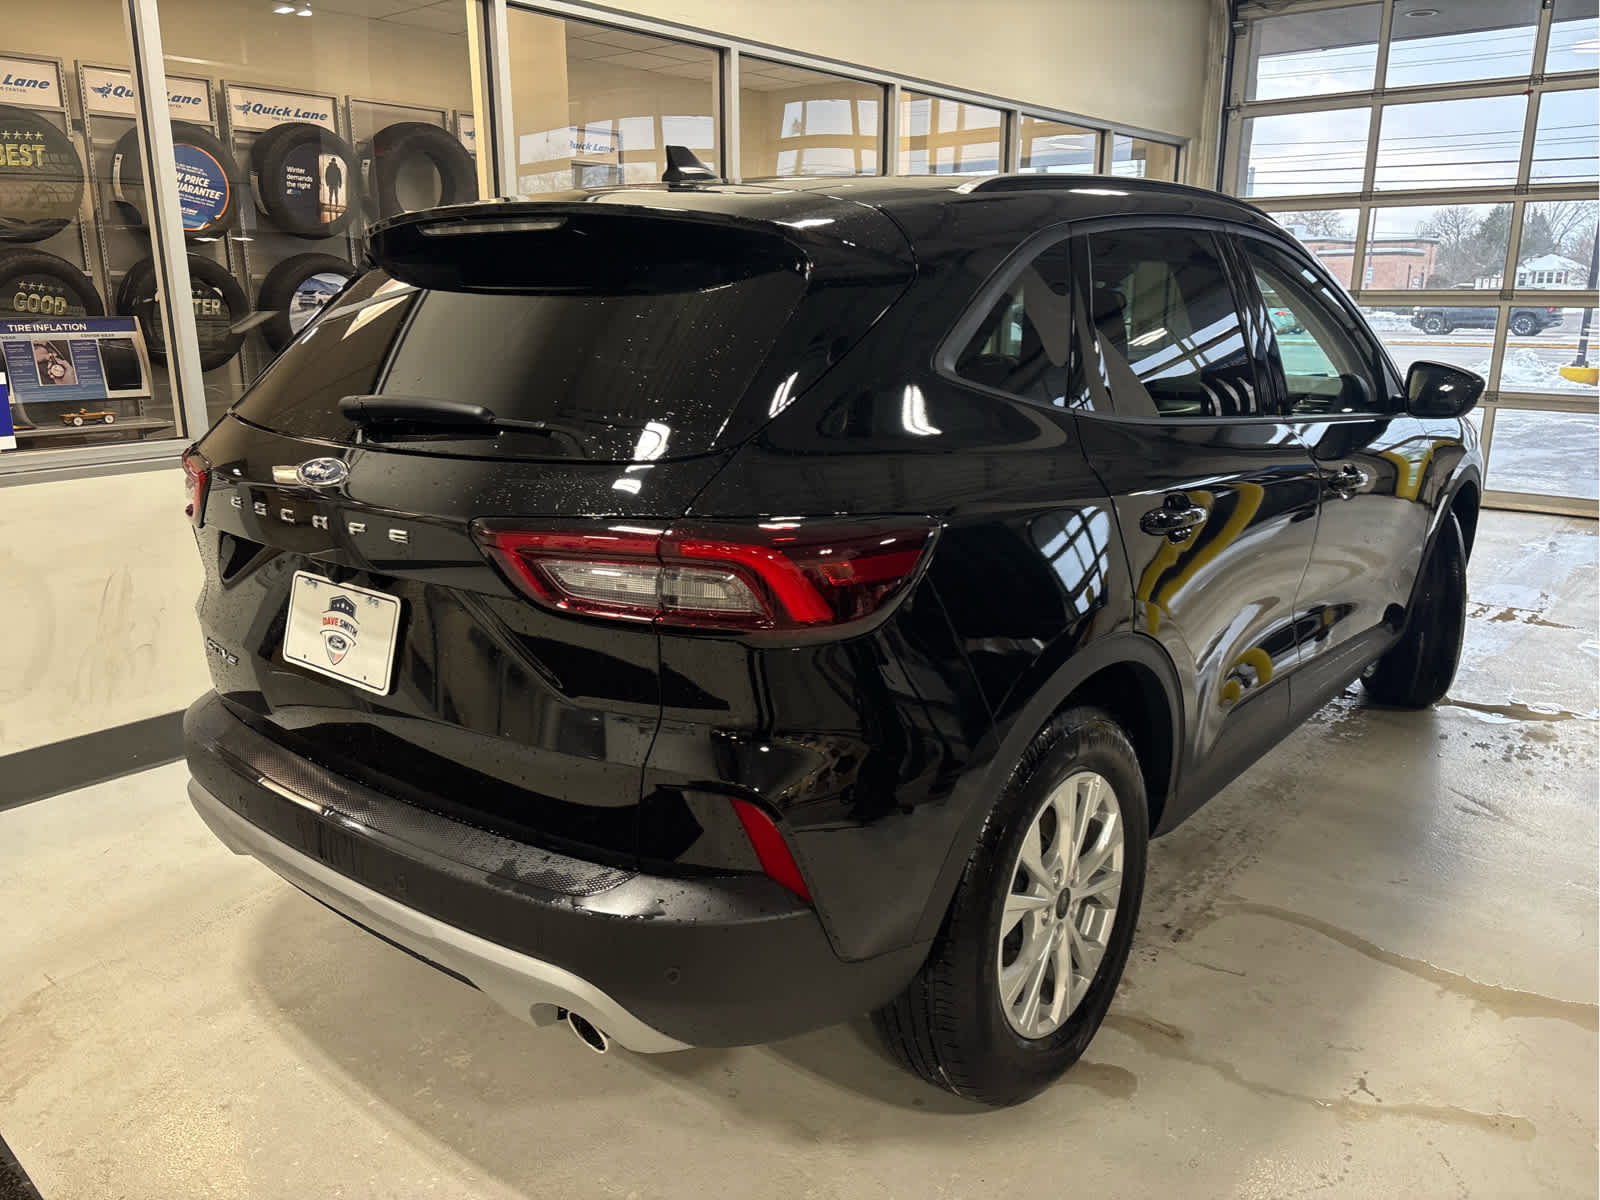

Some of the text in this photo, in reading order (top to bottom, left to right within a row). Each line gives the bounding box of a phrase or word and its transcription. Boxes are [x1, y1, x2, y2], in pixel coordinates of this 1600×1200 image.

[3, 74, 50, 89] Lane
[252, 103, 292, 117] Quick
[294, 108, 328, 121] Lane
[286, 166, 306, 174] Winter
[286, 174, 313, 183] demands
[184, 174, 209, 188] PRICE
[176, 182, 222, 201] UARANTEE
[14, 291, 68, 316] GOOD
[192, 298, 222, 316] TER
[7, 323, 87, 332] TIRE INFLATION
[231, 496, 409, 544] ESCAPE
[322, 616, 358, 638] DAVE SMITH
